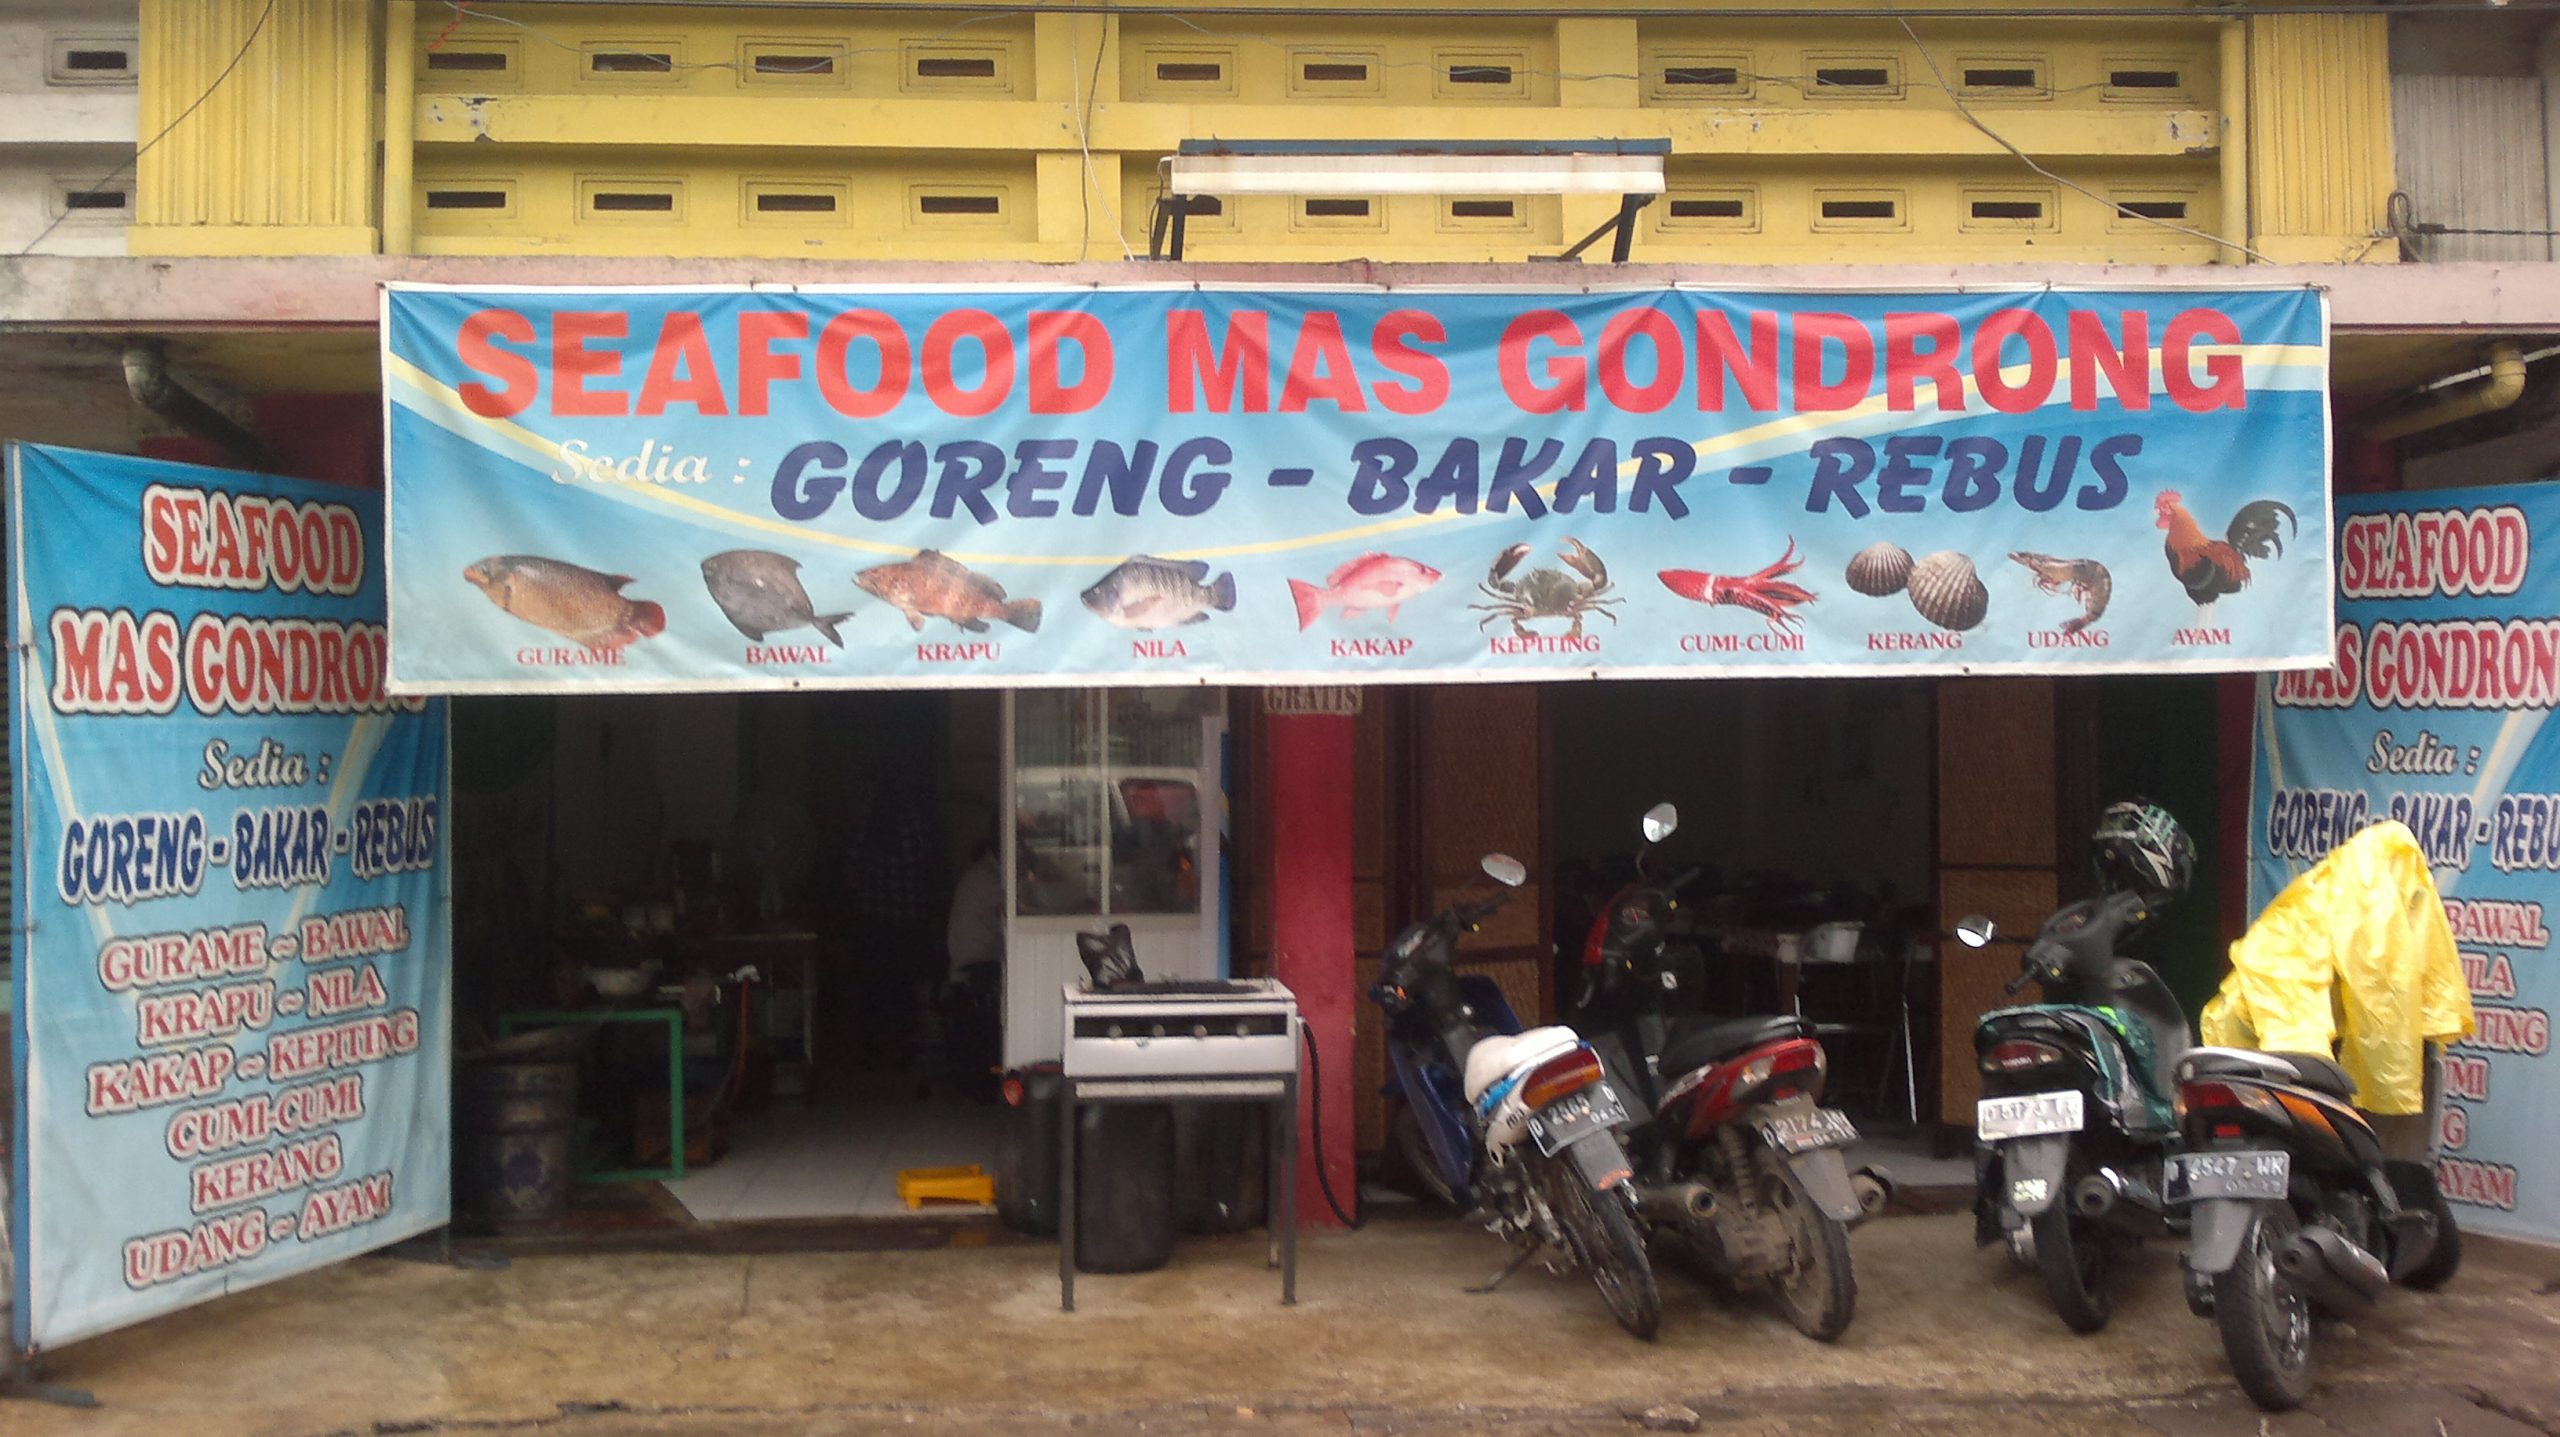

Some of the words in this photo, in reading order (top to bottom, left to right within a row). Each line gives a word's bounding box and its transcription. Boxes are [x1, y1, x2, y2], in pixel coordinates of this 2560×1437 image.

[455, 308, 1115, 419] SEAFOOD
[1166, 309, 1451, 415] MAS
[1498, 307, 2247, 415] GONDRONG
[551, 438, 713, 487] Sedia
[769, 437, 1233, 526] GORENG
[1347, 436, 1697, 521] BAKAR
[1805, 433, 2144, 520] REBUS
[147, 487, 361, 593] SEAFOOD
[2342, 507, 2528, 597] SEAFOOD
[54, 612, 179, 712] MAS
[187, 616, 426, 711] GONDRO
[516, 647, 627, 667] GURAME
[745, 645, 832, 665] BAWAL
[916, 641, 1001, 663] KRAPU
[1132, 640, 1188, 658] NILA
[1330, 638, 1414, 656] KAKAP
[1489, 634, 1600, 655] KEPITING
[1679, 633, 1805, 653] CUMI-CUMI
[1867, 632, 1962, 651] KERANG
[2026, 630, 2110, 649] UDANG
[2170, 628, 2231, 647] AYAM
[2367, 620, 2560, 708] GONDRON
[199, 738, 309, 789] Sedia
[2367, 730, 2460, 776] Sedia
[60, 814, 205, 904] GORENG
[233, 806, 332, 889] BAKAR
[353, 796, 436, 878] REBUS
[2492, 792, 2560, 873] REBU
[99, 926, 267, 991] GURAME
[301, 908, 410, 963] BAWAL
[2459, 951, 2517, 999] ILA
[138, 979, 275, 1047] KRAPU
[307, 963, 387, 1017] NILA
[87, 1044, 232, 1117] KAKAP
[268, 1008, 420, 1081] KEPITING
[167, 1073, 364, 1160] CUMI-CUMI
[192, 1133, 342, 1213] KERANG
[124, 1207, 267, 1287] UDANG
[299, 1171, 393, 1241] AYAM
